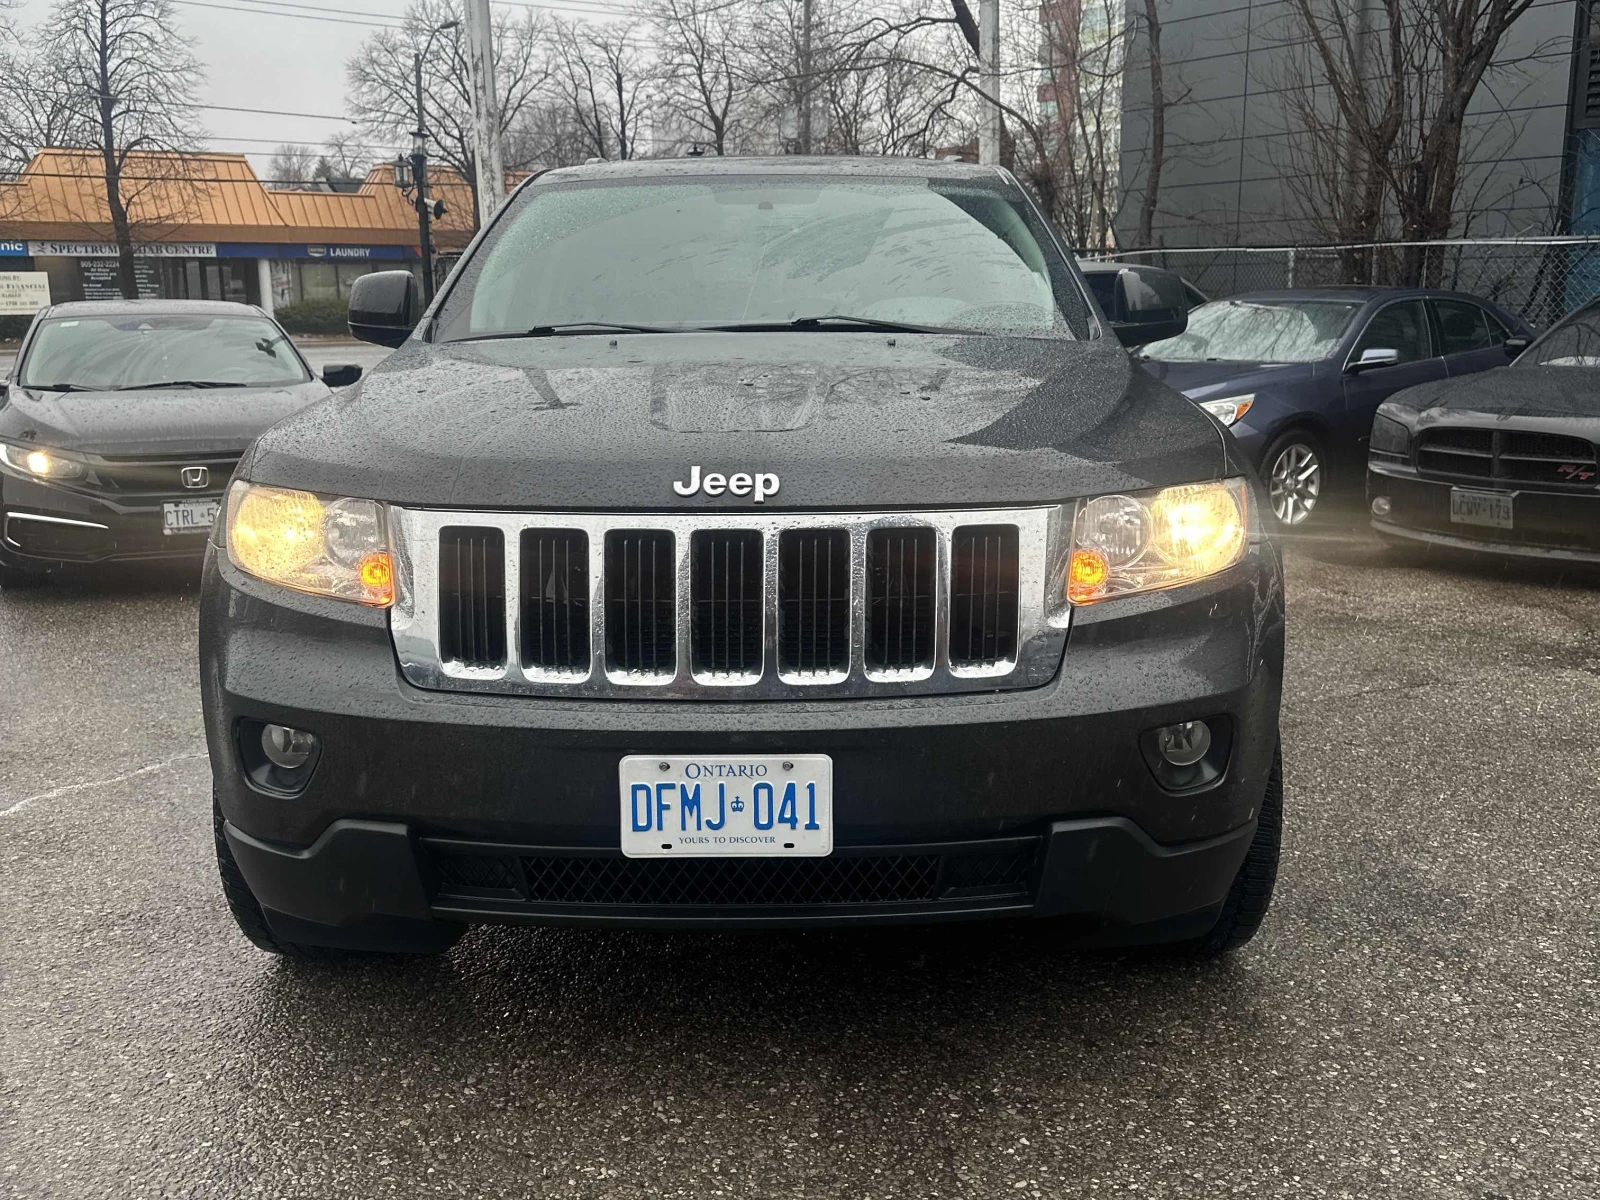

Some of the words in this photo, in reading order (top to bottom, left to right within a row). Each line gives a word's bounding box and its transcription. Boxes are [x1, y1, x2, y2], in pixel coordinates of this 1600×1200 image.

[1, 241, 23, 251] nic
[50, 243, 118, 254] SPECTRUM
[165, 243, 213, 255] CENTRE
[330, 248, 370, 257] LAUNDRY
[673, 465, 780, 503] Jeep
[165, 509, 199, 526] CTRL
[685, 763, 768, 779] ONTARIO
[630, 782, 725, 832] DFMJ
[753, 781, 820, 831] 041
[679, 836, 710, 844] YOURS
[714, 836, 726, 844] TO
[729, 836, 776, 844] DISCOVER
